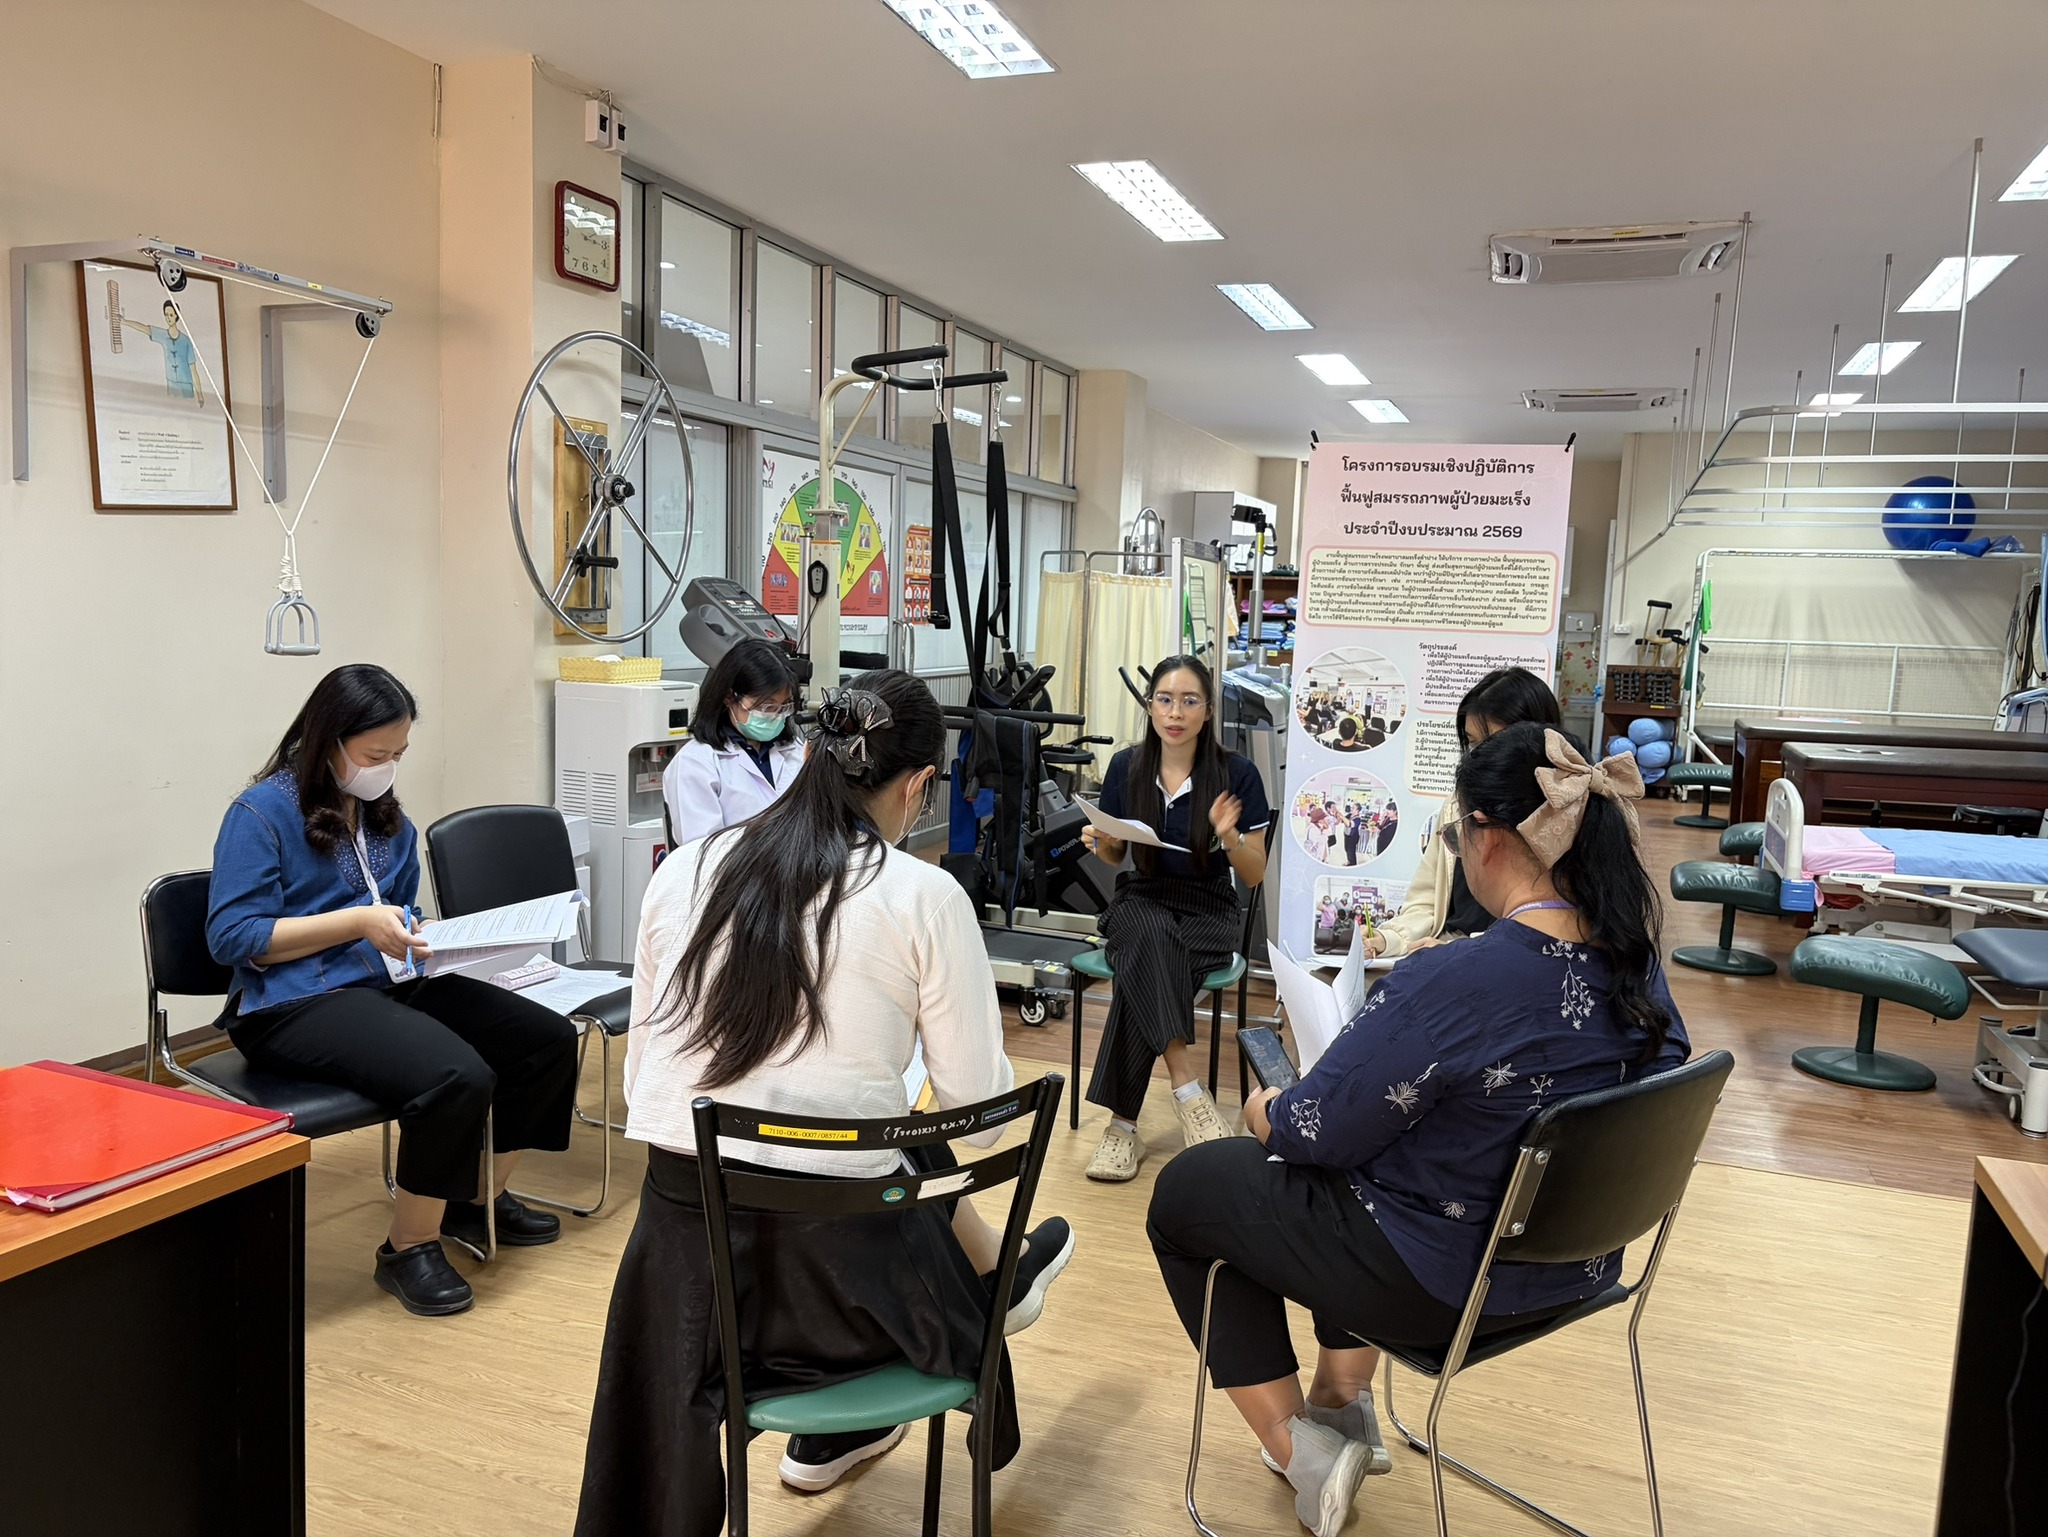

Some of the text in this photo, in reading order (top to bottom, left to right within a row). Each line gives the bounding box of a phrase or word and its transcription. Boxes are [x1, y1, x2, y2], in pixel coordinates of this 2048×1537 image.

[601, 240, 608, 250] 3
[582, 261, 589, 271] 6
[1342, 456, 1535, 478] โครงการอบรมเชิงปฏิบัติการ
[1340, 483, 1531, 510] ฟื้นฟูสมรรถภาพผู้ป่วยมะเร็ง
[1343, 520, 1523, 538] ประจำปีงบประมาณ 2569
[1419, 642, 1457, 651] วัตถุประสงค์
